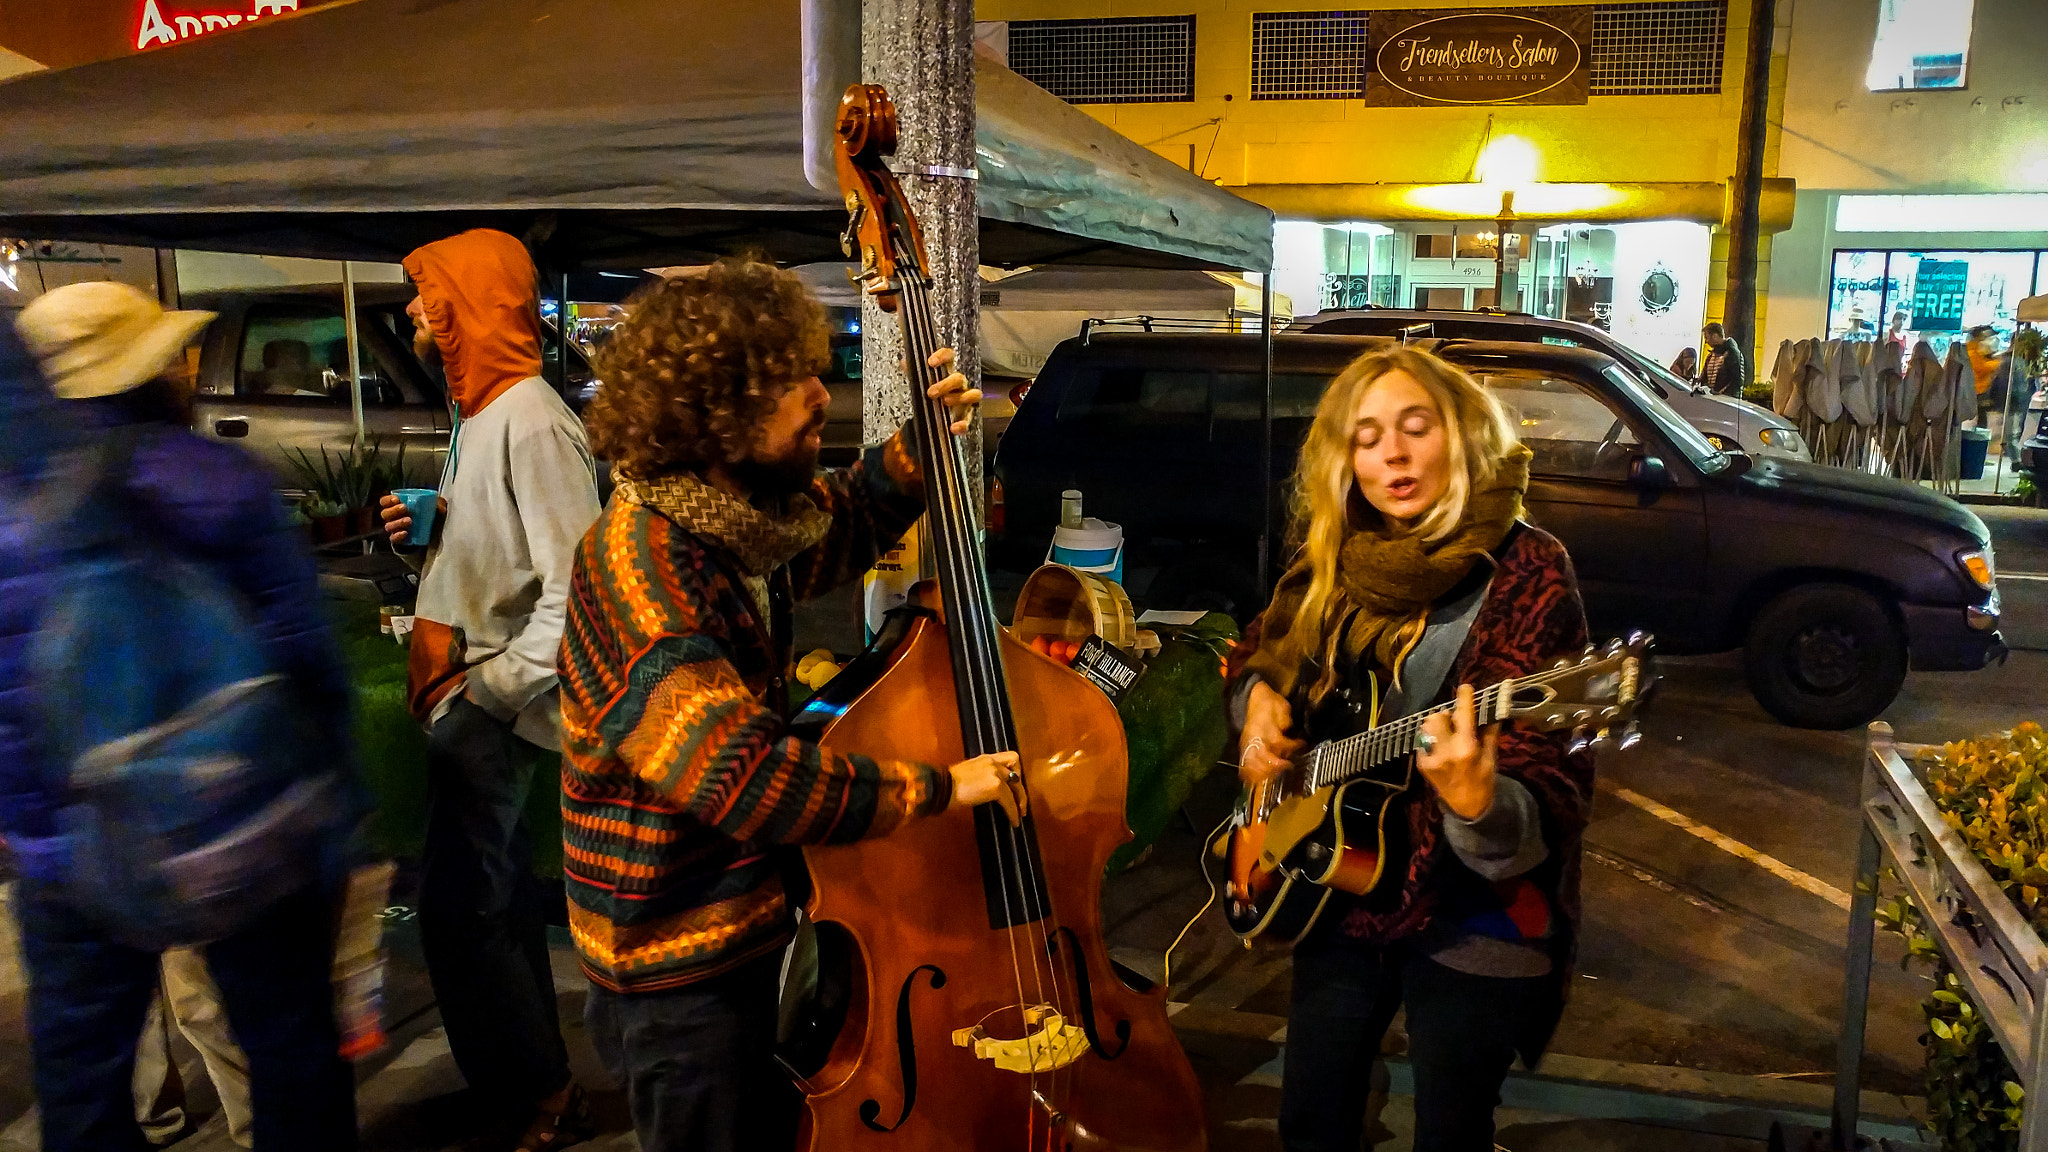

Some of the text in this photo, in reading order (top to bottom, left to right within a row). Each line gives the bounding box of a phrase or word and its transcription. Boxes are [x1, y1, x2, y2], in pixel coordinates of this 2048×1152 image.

[1397, 34, 1559, 72] Trendsetters Salon
[1419, 74, 1470, 82] BEAUTY
[1478, 73, 1547, 82] BOUTIQUE
[1913, 293, 1963, 318] FREE
[1097, 653, 1117, 676] HILL
[1109, 661, 1137, 689] RANCH
